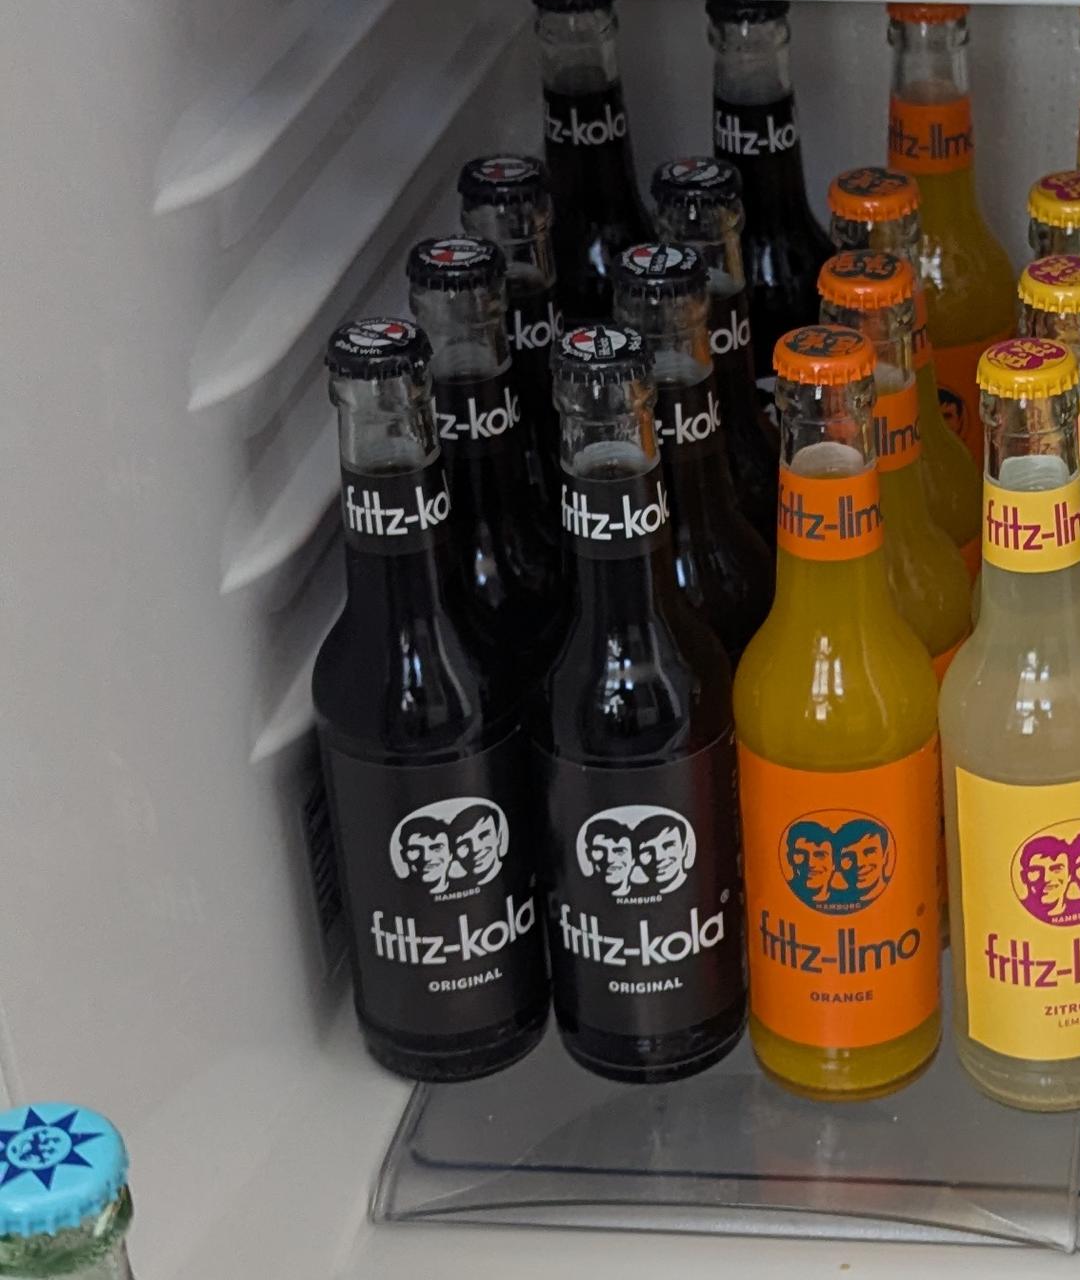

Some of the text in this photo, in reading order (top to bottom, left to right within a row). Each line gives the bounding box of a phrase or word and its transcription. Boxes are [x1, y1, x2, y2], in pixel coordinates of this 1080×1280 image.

[616, 894, 663, 905] HAMBURG
[371, 894, 535, 964] fritz-kola
[560, 904, 725, 966] fritz-kola
[760, 910, 921, 974] fritz-limo
[428, 968, 502, 992] ORIGINAL
[608, 977, 683, 994] ORIGINAL
[810, 990, 873, 1003] ORANGE
